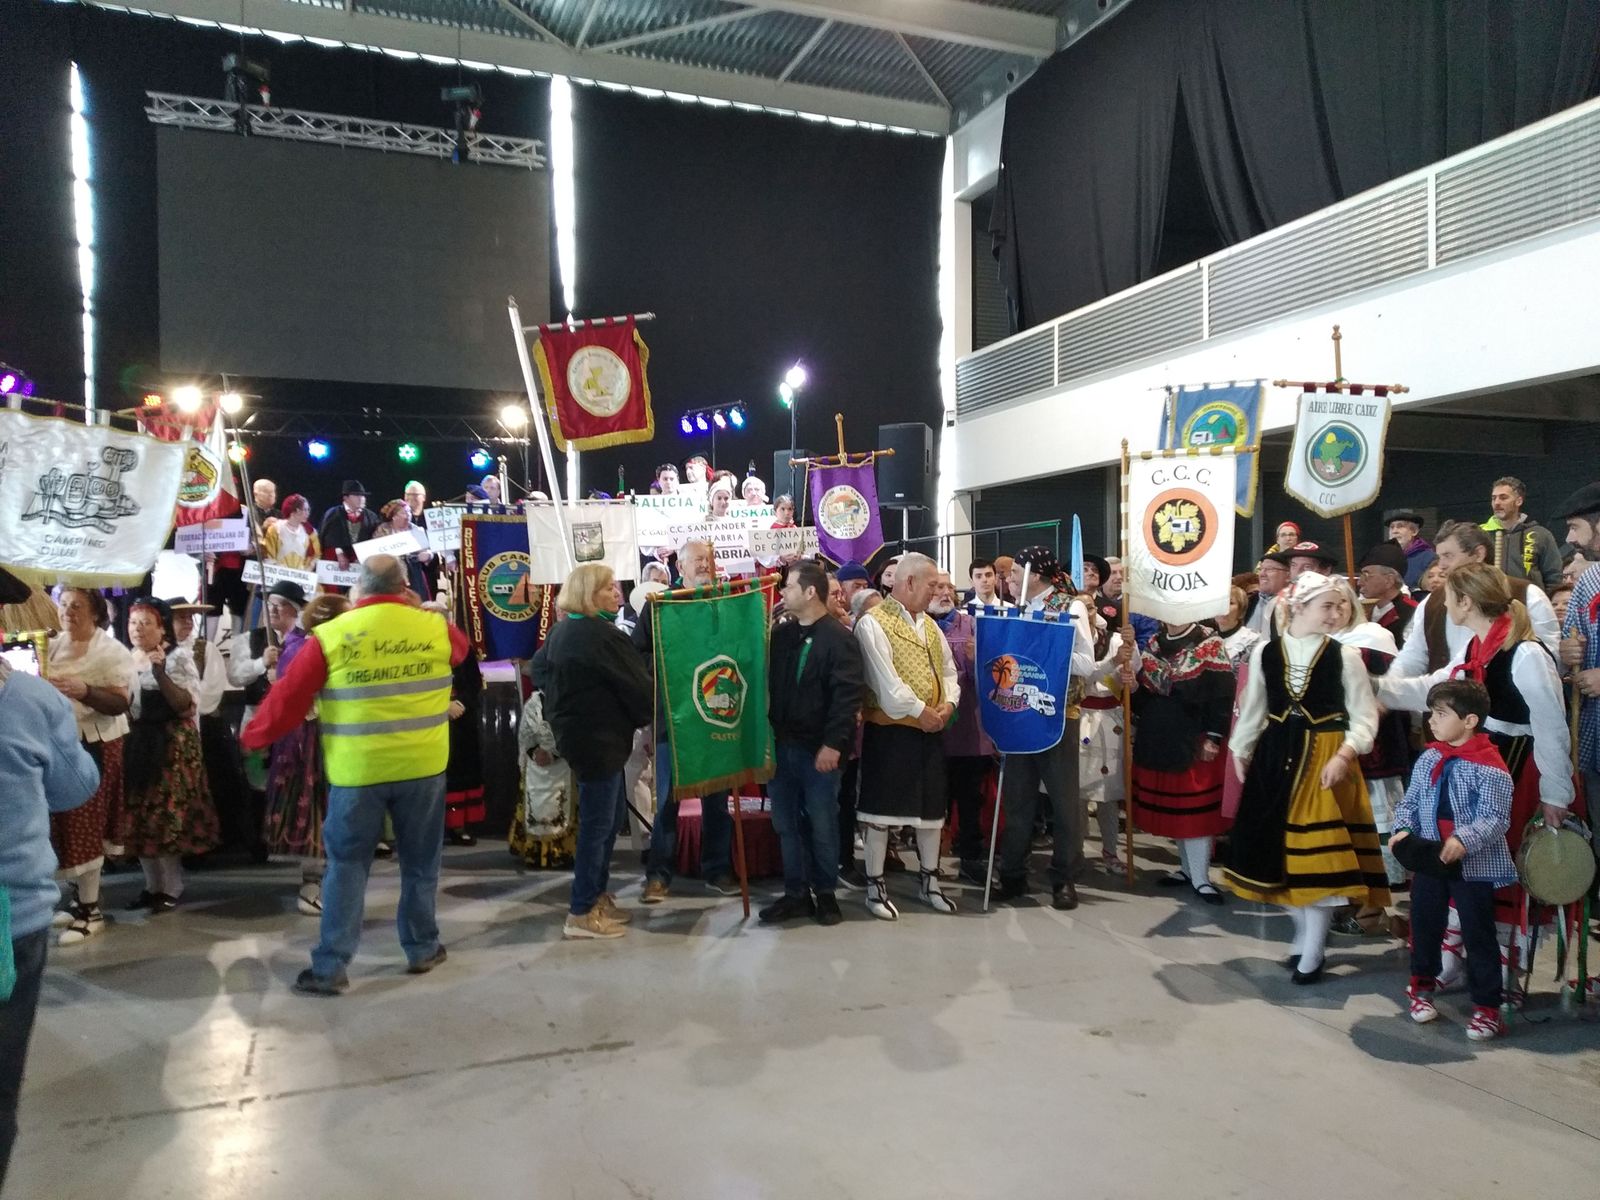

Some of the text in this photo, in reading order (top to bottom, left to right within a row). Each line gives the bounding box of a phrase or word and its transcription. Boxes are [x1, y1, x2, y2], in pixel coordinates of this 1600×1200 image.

[687, 522, 746, 533] SANTANDER
[766, 529, 819, 540] CANTARO
[754, 539, 821, 553] DE CAMPSMO
[464, 527, 483, 643] BUEN VECINO
[1150, 568, 1209, 593] RIOJA
